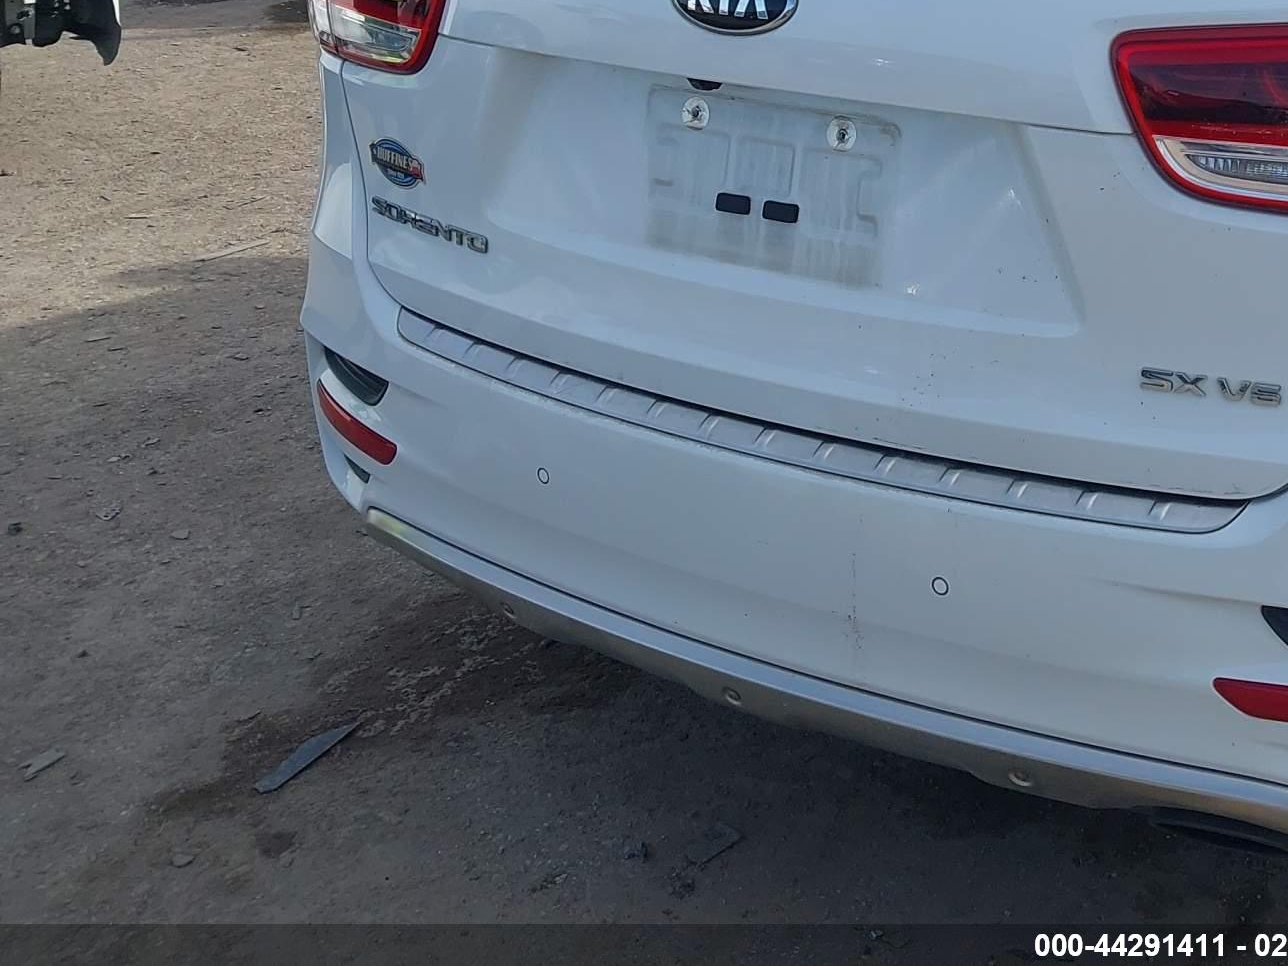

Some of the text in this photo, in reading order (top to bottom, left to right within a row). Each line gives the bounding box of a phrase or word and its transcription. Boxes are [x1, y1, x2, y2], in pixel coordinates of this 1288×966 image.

[371, 195, 489, 254] SORENTO
[1139, 366, 1282, 407] SX V6
